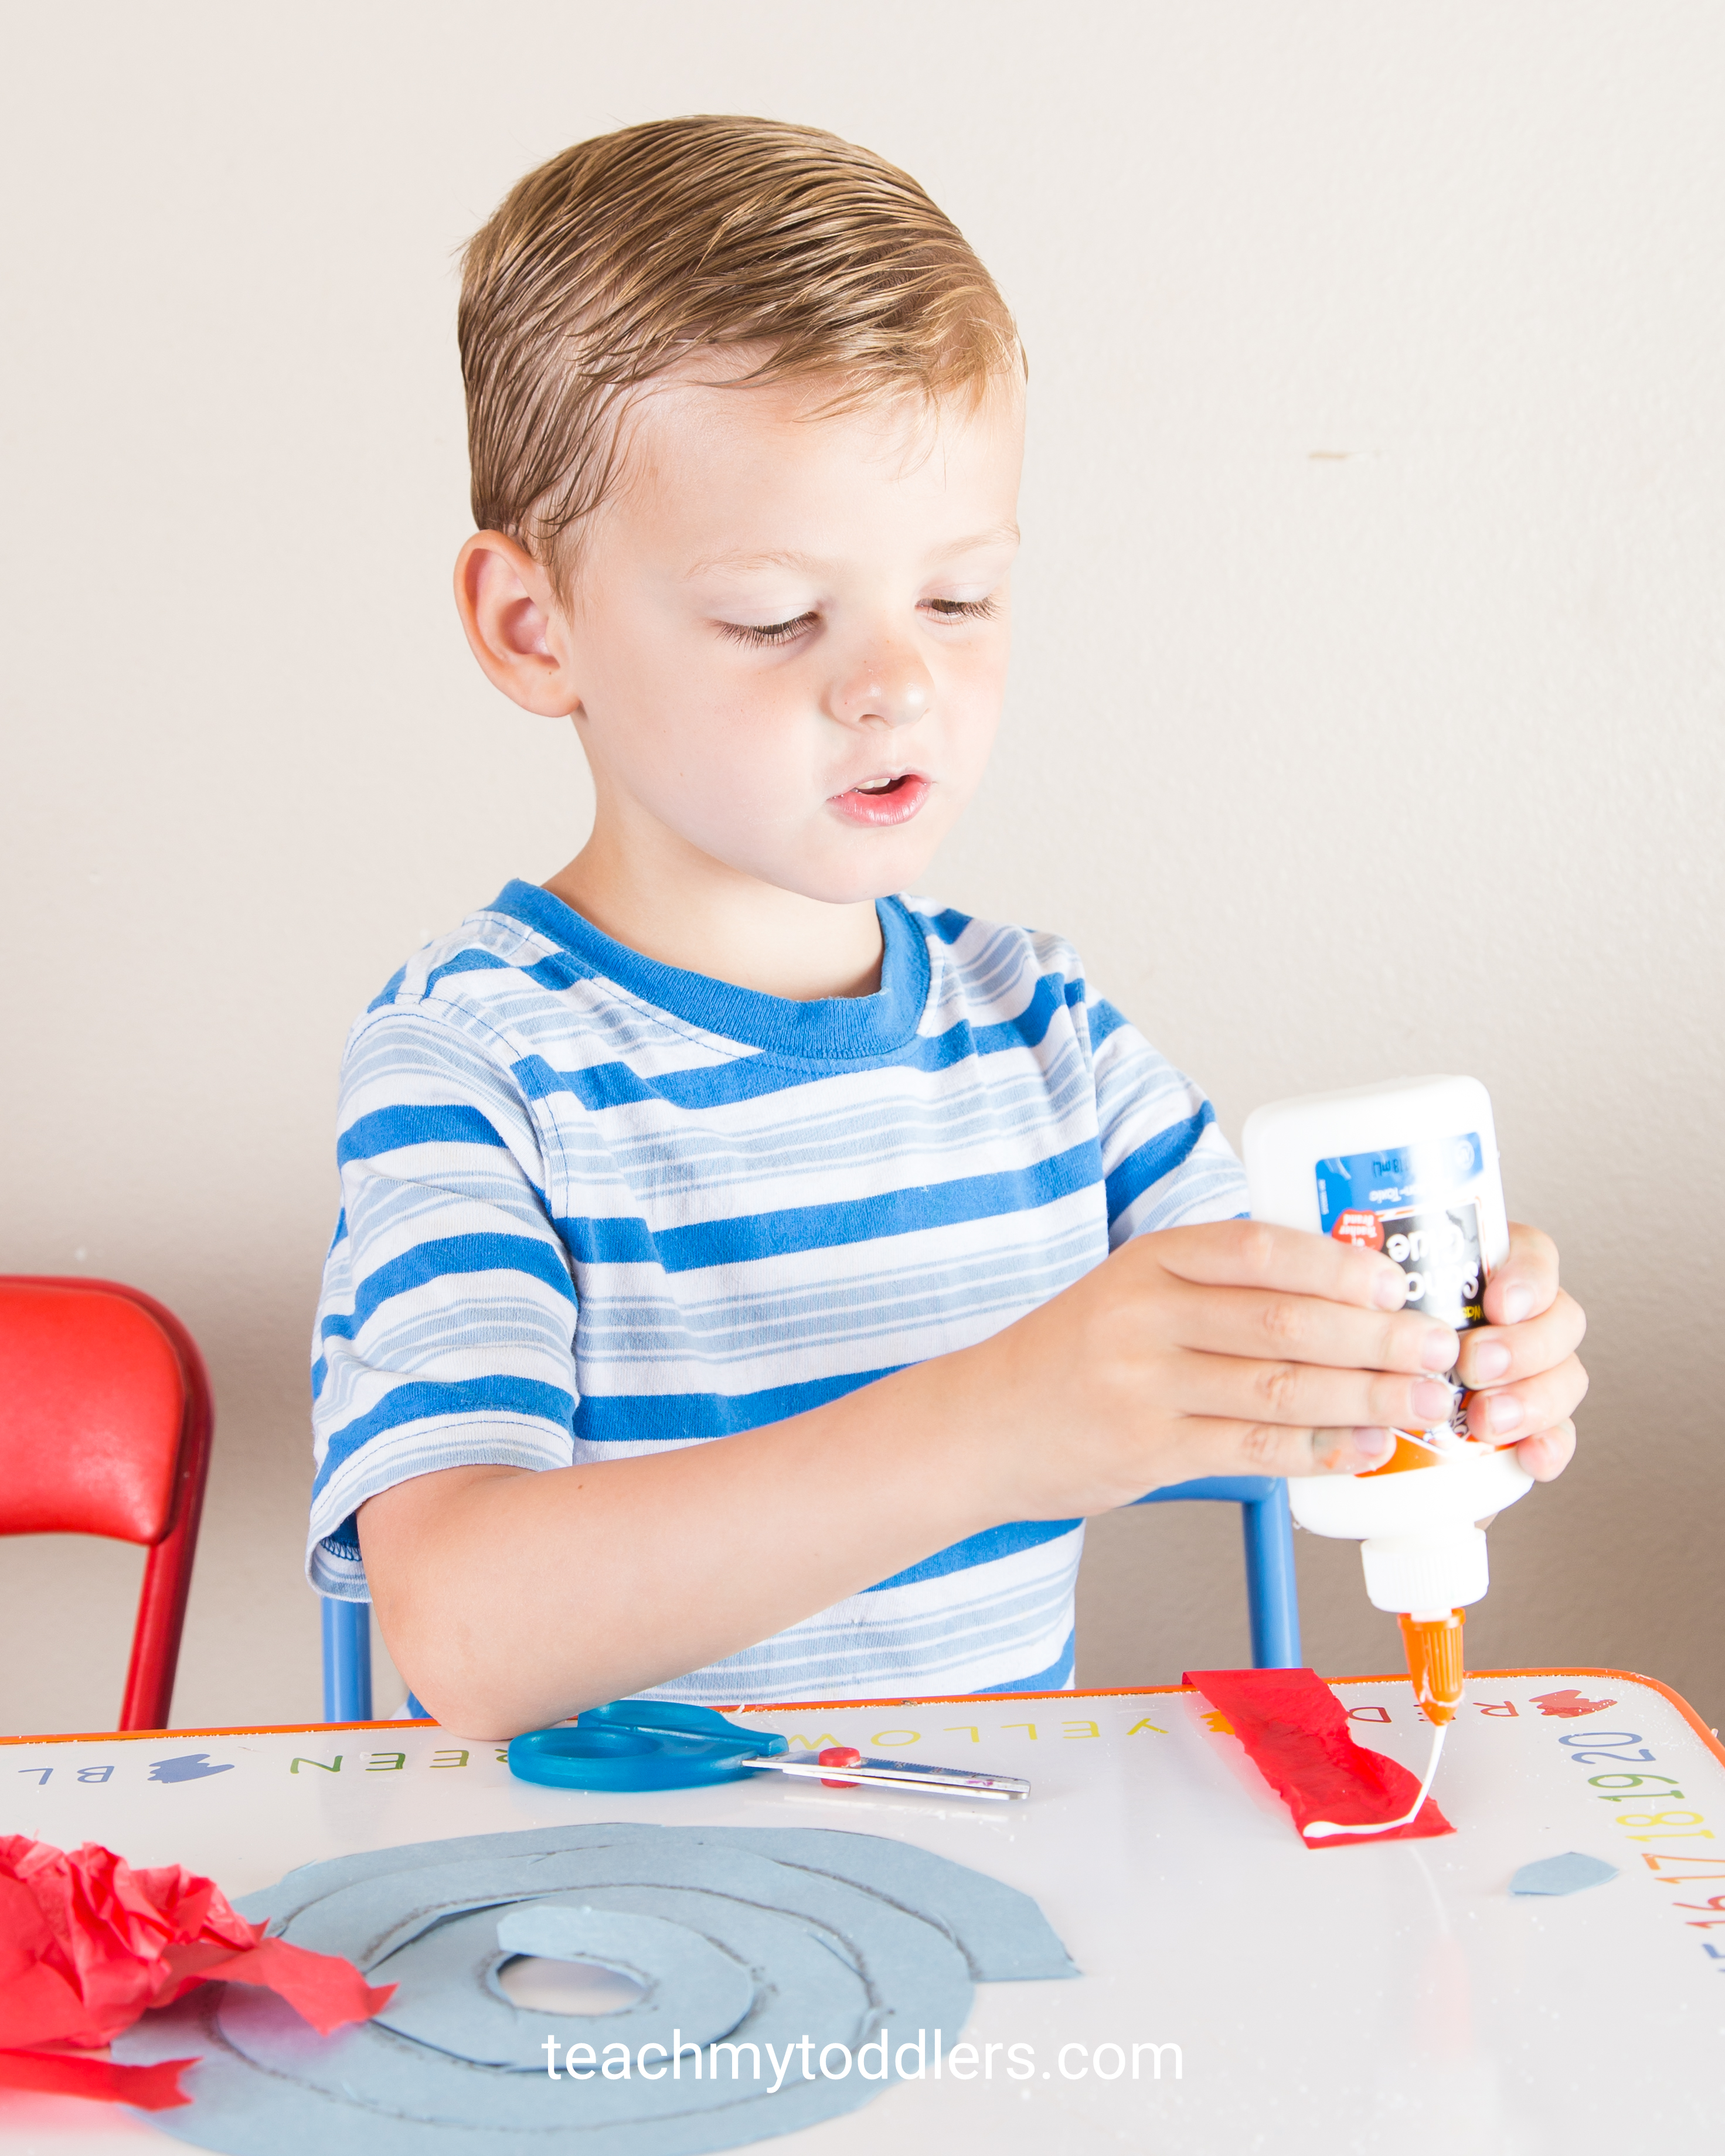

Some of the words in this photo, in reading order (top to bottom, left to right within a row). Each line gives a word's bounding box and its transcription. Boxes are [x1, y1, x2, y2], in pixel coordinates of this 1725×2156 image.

[1369, 1184, 1426, 1204] on-Toxic
[1386, 1224, 1465, 1266] Glue
[1405, 1261, 1479, 1306] Scho
[1349, 1701, 1519, 1723] RD
[788, 1718, 1169, 1749] YELLOW
[1559, 1732, 1656, 1765] 20
[290, 1749, 508, 1774] EEN
[1587, 1773, 1685, 1802] 19
[1615, 1811, 1716, 1842] 18
[1642, 1853, 1725, 1884] 17
